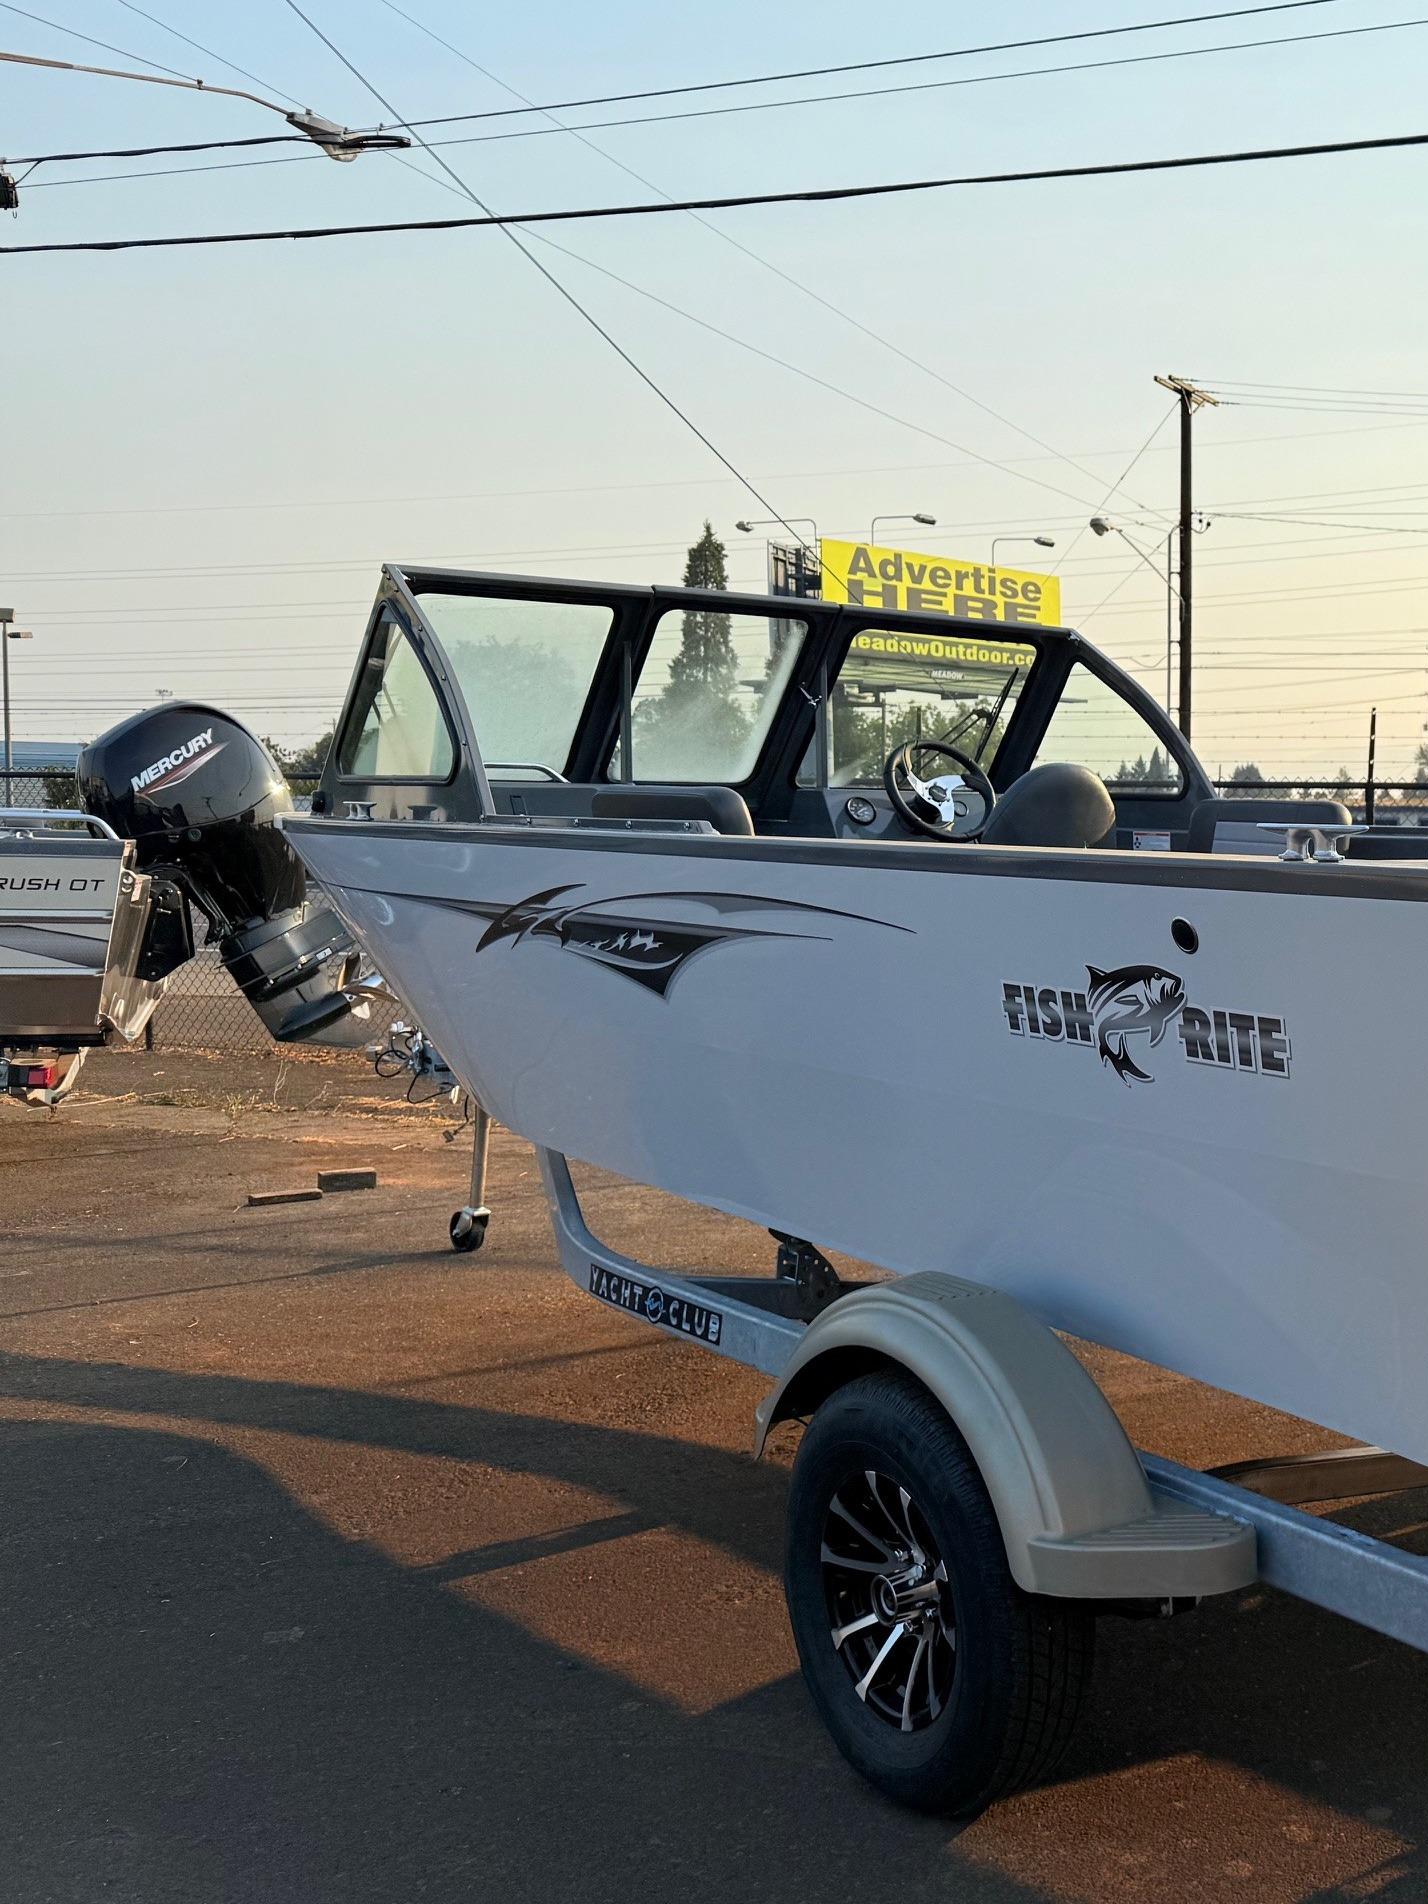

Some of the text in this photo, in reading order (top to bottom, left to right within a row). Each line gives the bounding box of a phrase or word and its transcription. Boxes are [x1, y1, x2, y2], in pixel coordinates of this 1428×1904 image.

[847, 547, 1041, 602] Advertise
[131, 728, 213, 791] MERCURY
[69, 879, 105, 891] OT
[1002, 980, 1290, 1078] FISH RITE
[591, 1265, 720, 1342] YACHT CLUB
